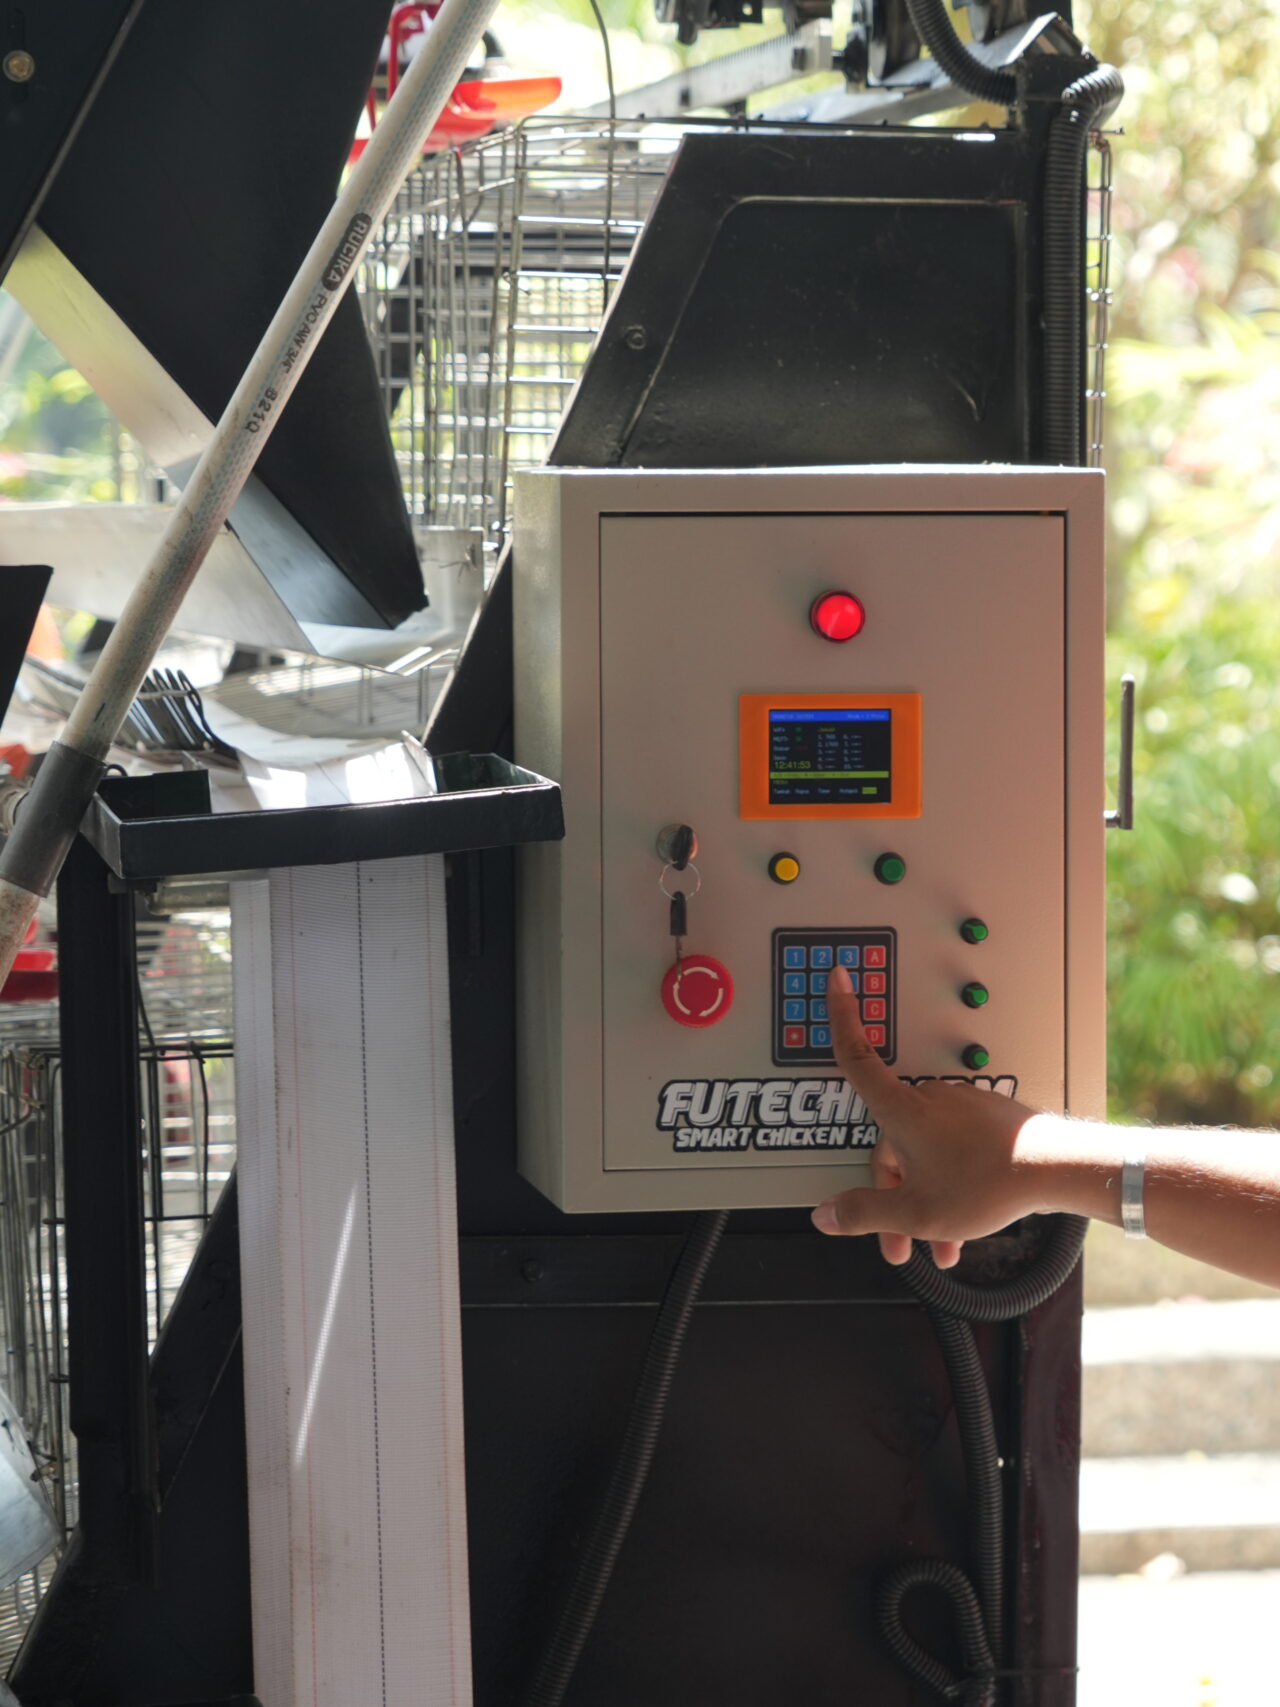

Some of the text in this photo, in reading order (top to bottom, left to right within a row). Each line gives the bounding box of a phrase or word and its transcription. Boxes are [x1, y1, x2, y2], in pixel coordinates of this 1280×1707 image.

[327, 219, 370, 284] RUCIKA
[305, 293, 328, 324] PVC
[294, 324, 312, 349] AW
[774, 760, 812, 770] 12:41:53
[792, 951, 880, 963] 1 2 3 A
[791, 977, 880, 990] 4 5 B
[791, 1003, 800, 1016] 7
[870, 1003, 880, 1016] C
[818, 1030, 880, 1042] 0 D
[676, 1125, 880, 1148] SMART CHICKEN FA
